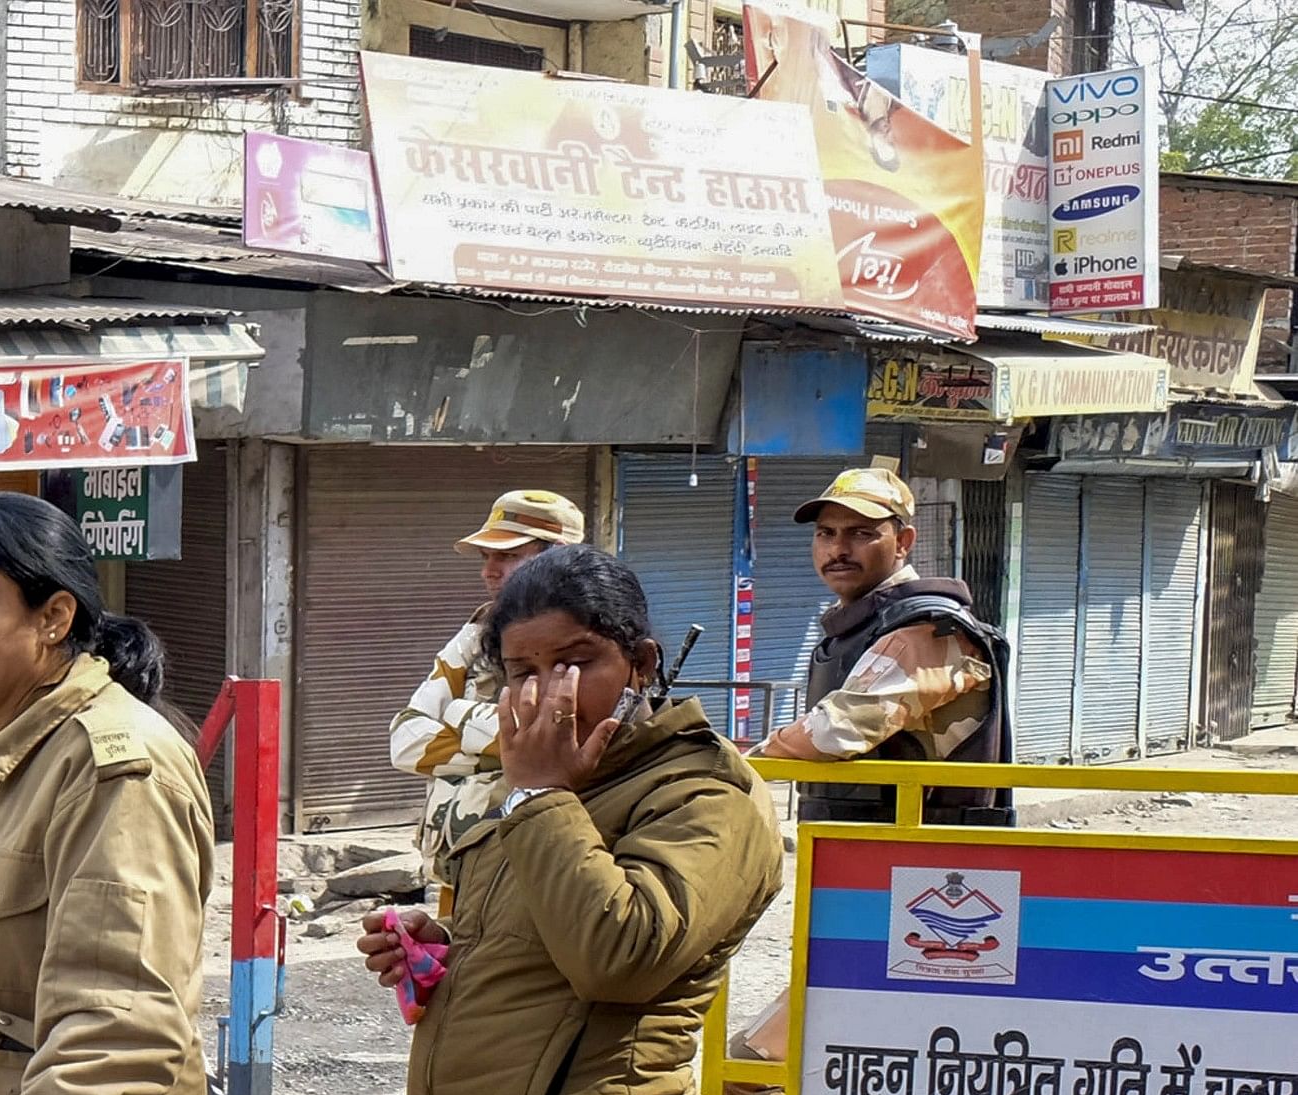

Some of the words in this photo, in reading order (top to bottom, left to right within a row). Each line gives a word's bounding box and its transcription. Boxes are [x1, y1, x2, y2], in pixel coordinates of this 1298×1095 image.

[1052, 75, 1140, 104] vivo
[1051, 103, 1140, 127] oppo
[1091, 130, 1141, 150] Redmi
[1075, 162, 1141, 181] ONEPLUS
[1062, 194, 1131, 213] SAMSUNG
[851, 255, 903, 294] itel
[1073, 254, 1138, 275] iPhone
[1055, 368, 1155, 406] COMMUNICATION
